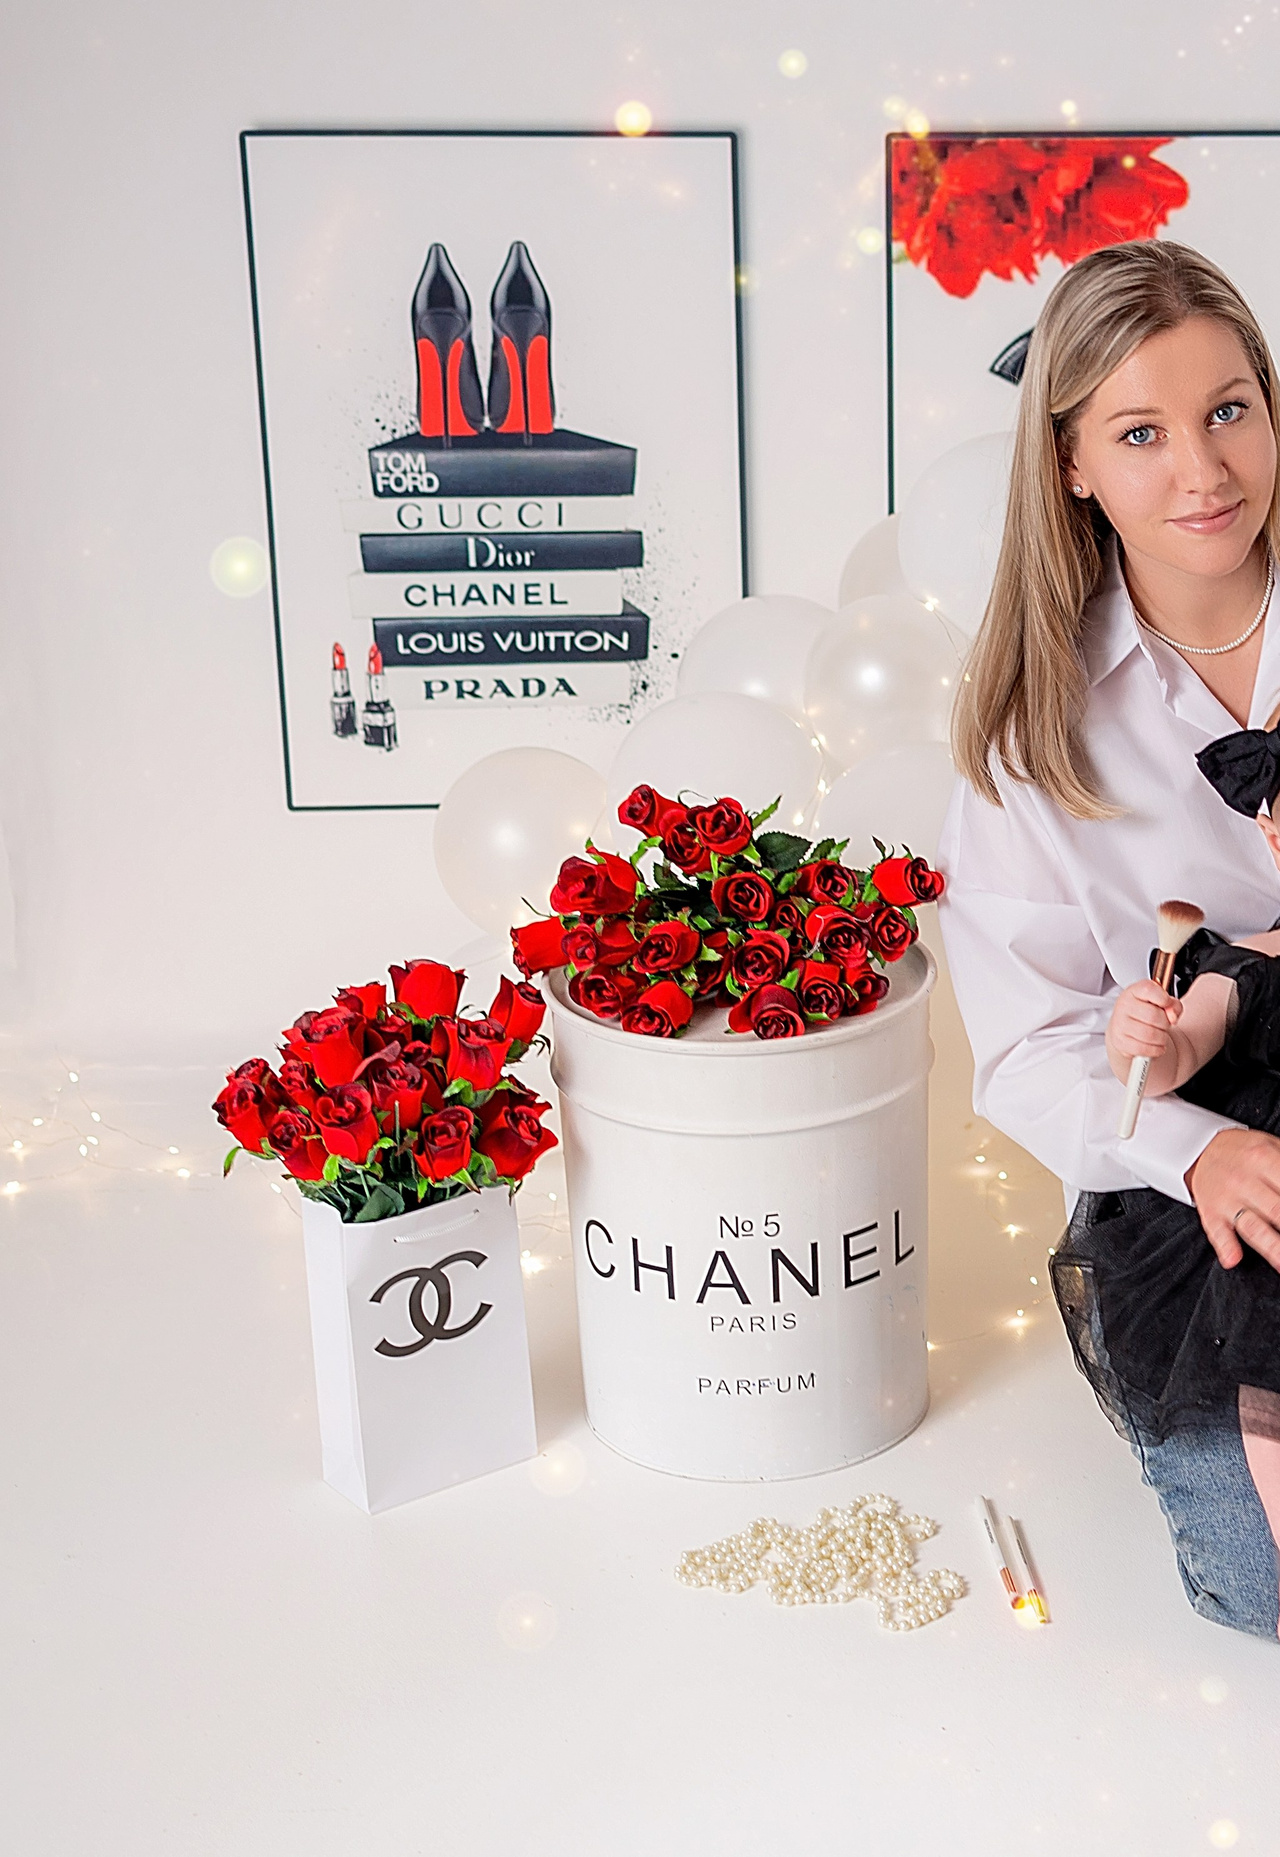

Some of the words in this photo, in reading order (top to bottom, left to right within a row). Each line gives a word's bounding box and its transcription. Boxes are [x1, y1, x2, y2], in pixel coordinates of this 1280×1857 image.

[374, 453, 426, 473] TOM
[376, 473, 440, 493] FORD
[397, 502, 563, 530] GUCCI
[466, 536, 536, 568] Dior
[404, 583, 569, 607] CHANEL
[397, 632, 485, 655] LOUIS
[492, 630, 629, 652] VUITTON
[423, 678, 578, 700] PRADA
[585, 1209, 915, 1306] CHANEL
[710, 1312, 798, 1333] PARIS
[698, 1371, 817, 1396] PARFUM
